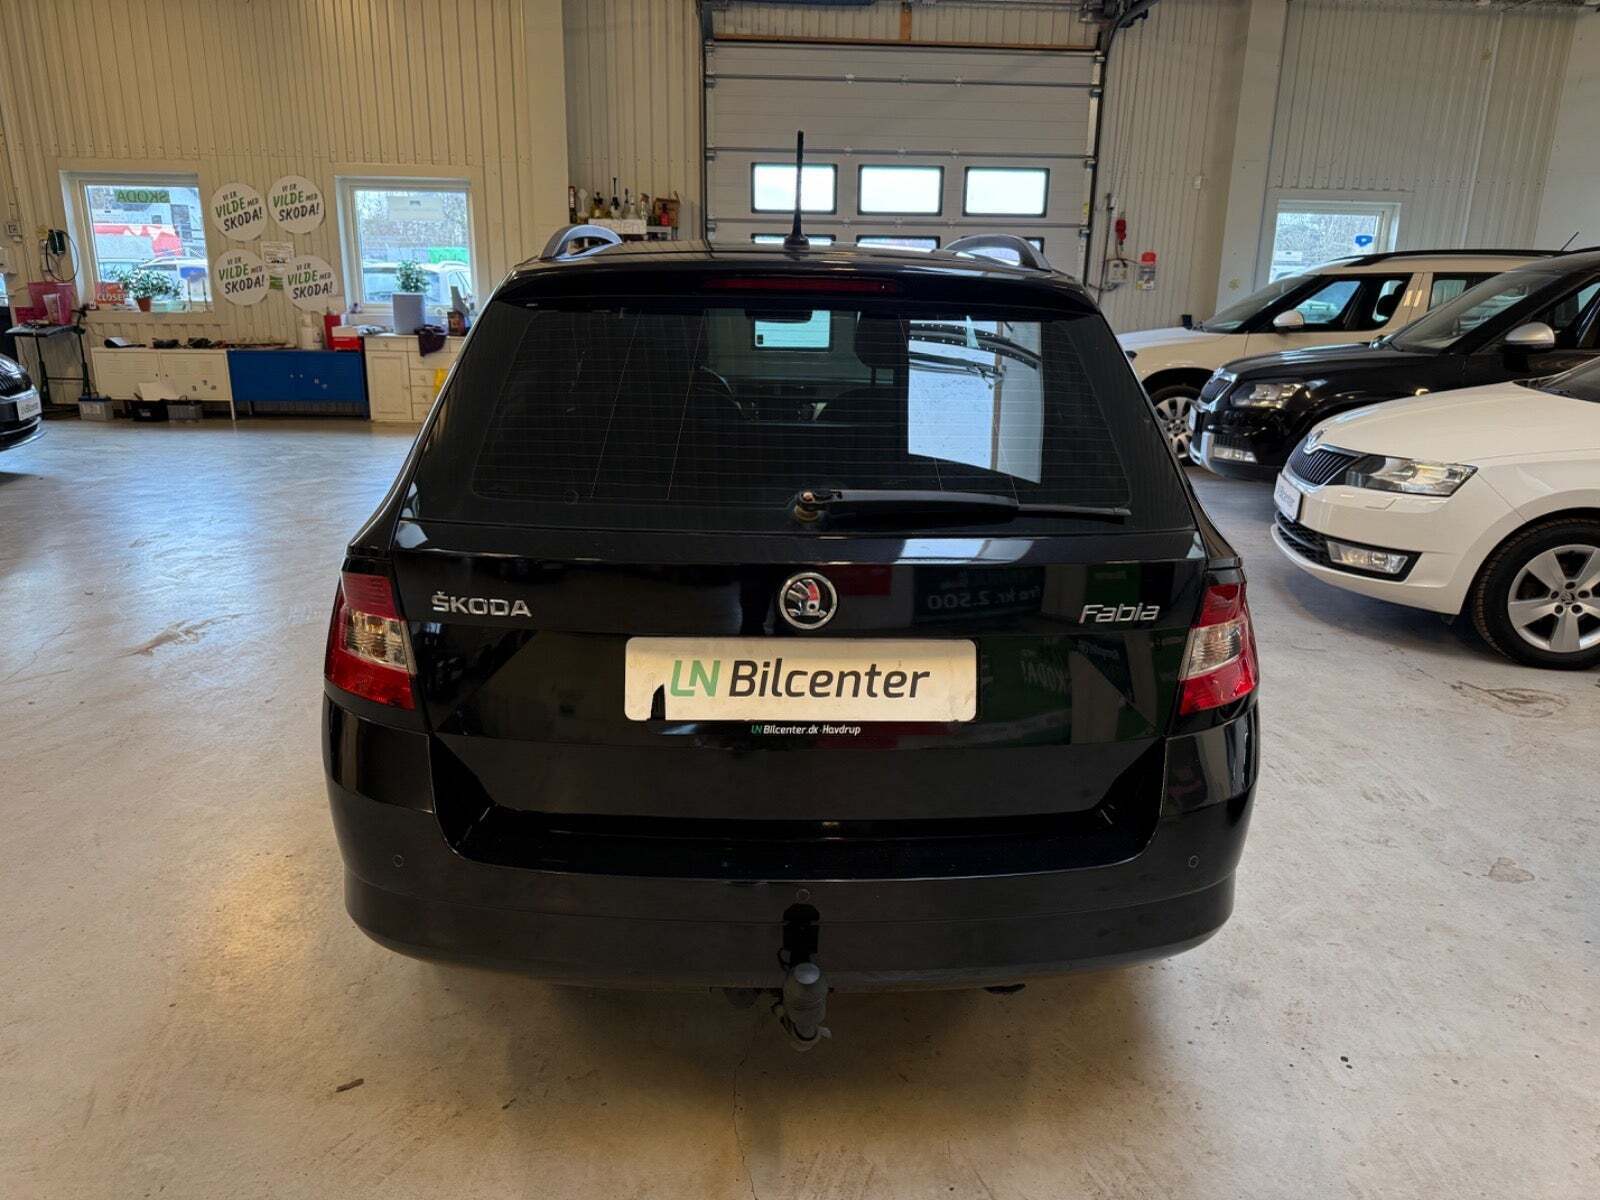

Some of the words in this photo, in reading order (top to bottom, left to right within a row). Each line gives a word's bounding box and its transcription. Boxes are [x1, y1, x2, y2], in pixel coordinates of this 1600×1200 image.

[229, 191, 237, 200] ER
[289, 183, 298, 191] ER
[215, 196, 246, 219] VILDE
[246, 198, 260, 207] MED
[272, 190, 305, 209] VILDE
[305, 193, 318, 202] MED
[223, 206, 262, 232] SKODA!
[279, 202, 320, 222] SKODA!
[234, 256, 242, 264] ER
[218, 263, 250, 281] VILDE
[287, 270, 318, 286] VILDE
[319, 271, 332, 280] MED
[224, 274, 265, 295] SKODA!
[292, 281, 333, 300] SKODA!
[431, 591, 533, 617] ŠKODA
[1078, 602, 1161, 624] Fabia
[669, 659, 721, 697] LN
[728, 657, 931, 698] Bilcenter
